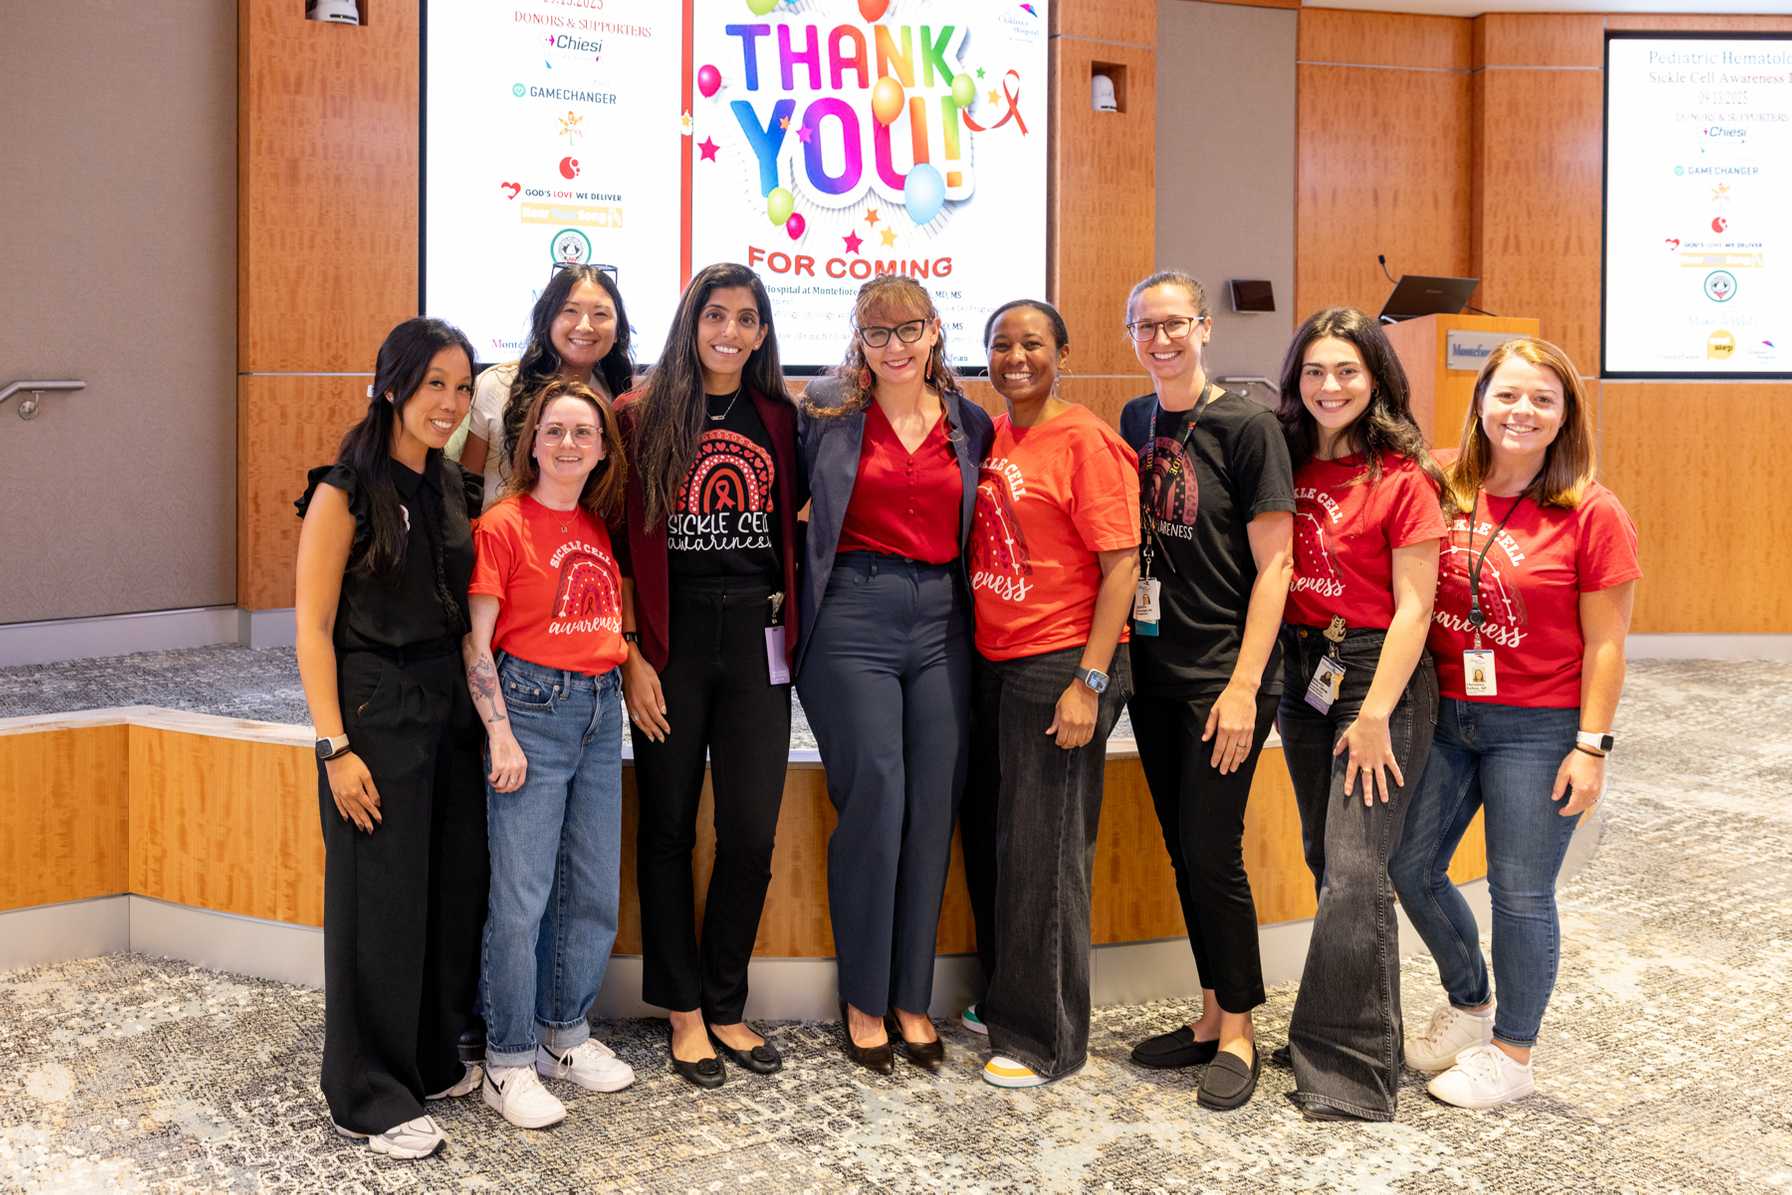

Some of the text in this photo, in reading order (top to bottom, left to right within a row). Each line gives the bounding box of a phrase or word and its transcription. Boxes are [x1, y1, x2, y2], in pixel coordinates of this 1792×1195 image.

[514, 11, 652, 37] DONORS & SUPPORTERS
[556, 34, 602, 52] Chiesi
[725, 24, 956, 91] THANK
[1649, 51, 1717, 64] Pediatric
[1649, 72, 1784, 84] Sickle Cell Awareness
[530, 86, 617, 104] GAMECHANGER
[730, 96, 962, 198] YOU!
[525, 189, 622, 201] GOD'S LOVE WE DELIVER
[748, 246, 953, 280] FOR COMING
[802, 286, 811, 294] at
[1005, 464, 1026, 502] CELL
[1317, 493, 1343, 524] CELL
[667, 512, 730, 535] SICKLE
[549, 540, 612, 568] SICKLE CELL
[970, 570, 1034, 602] eness
